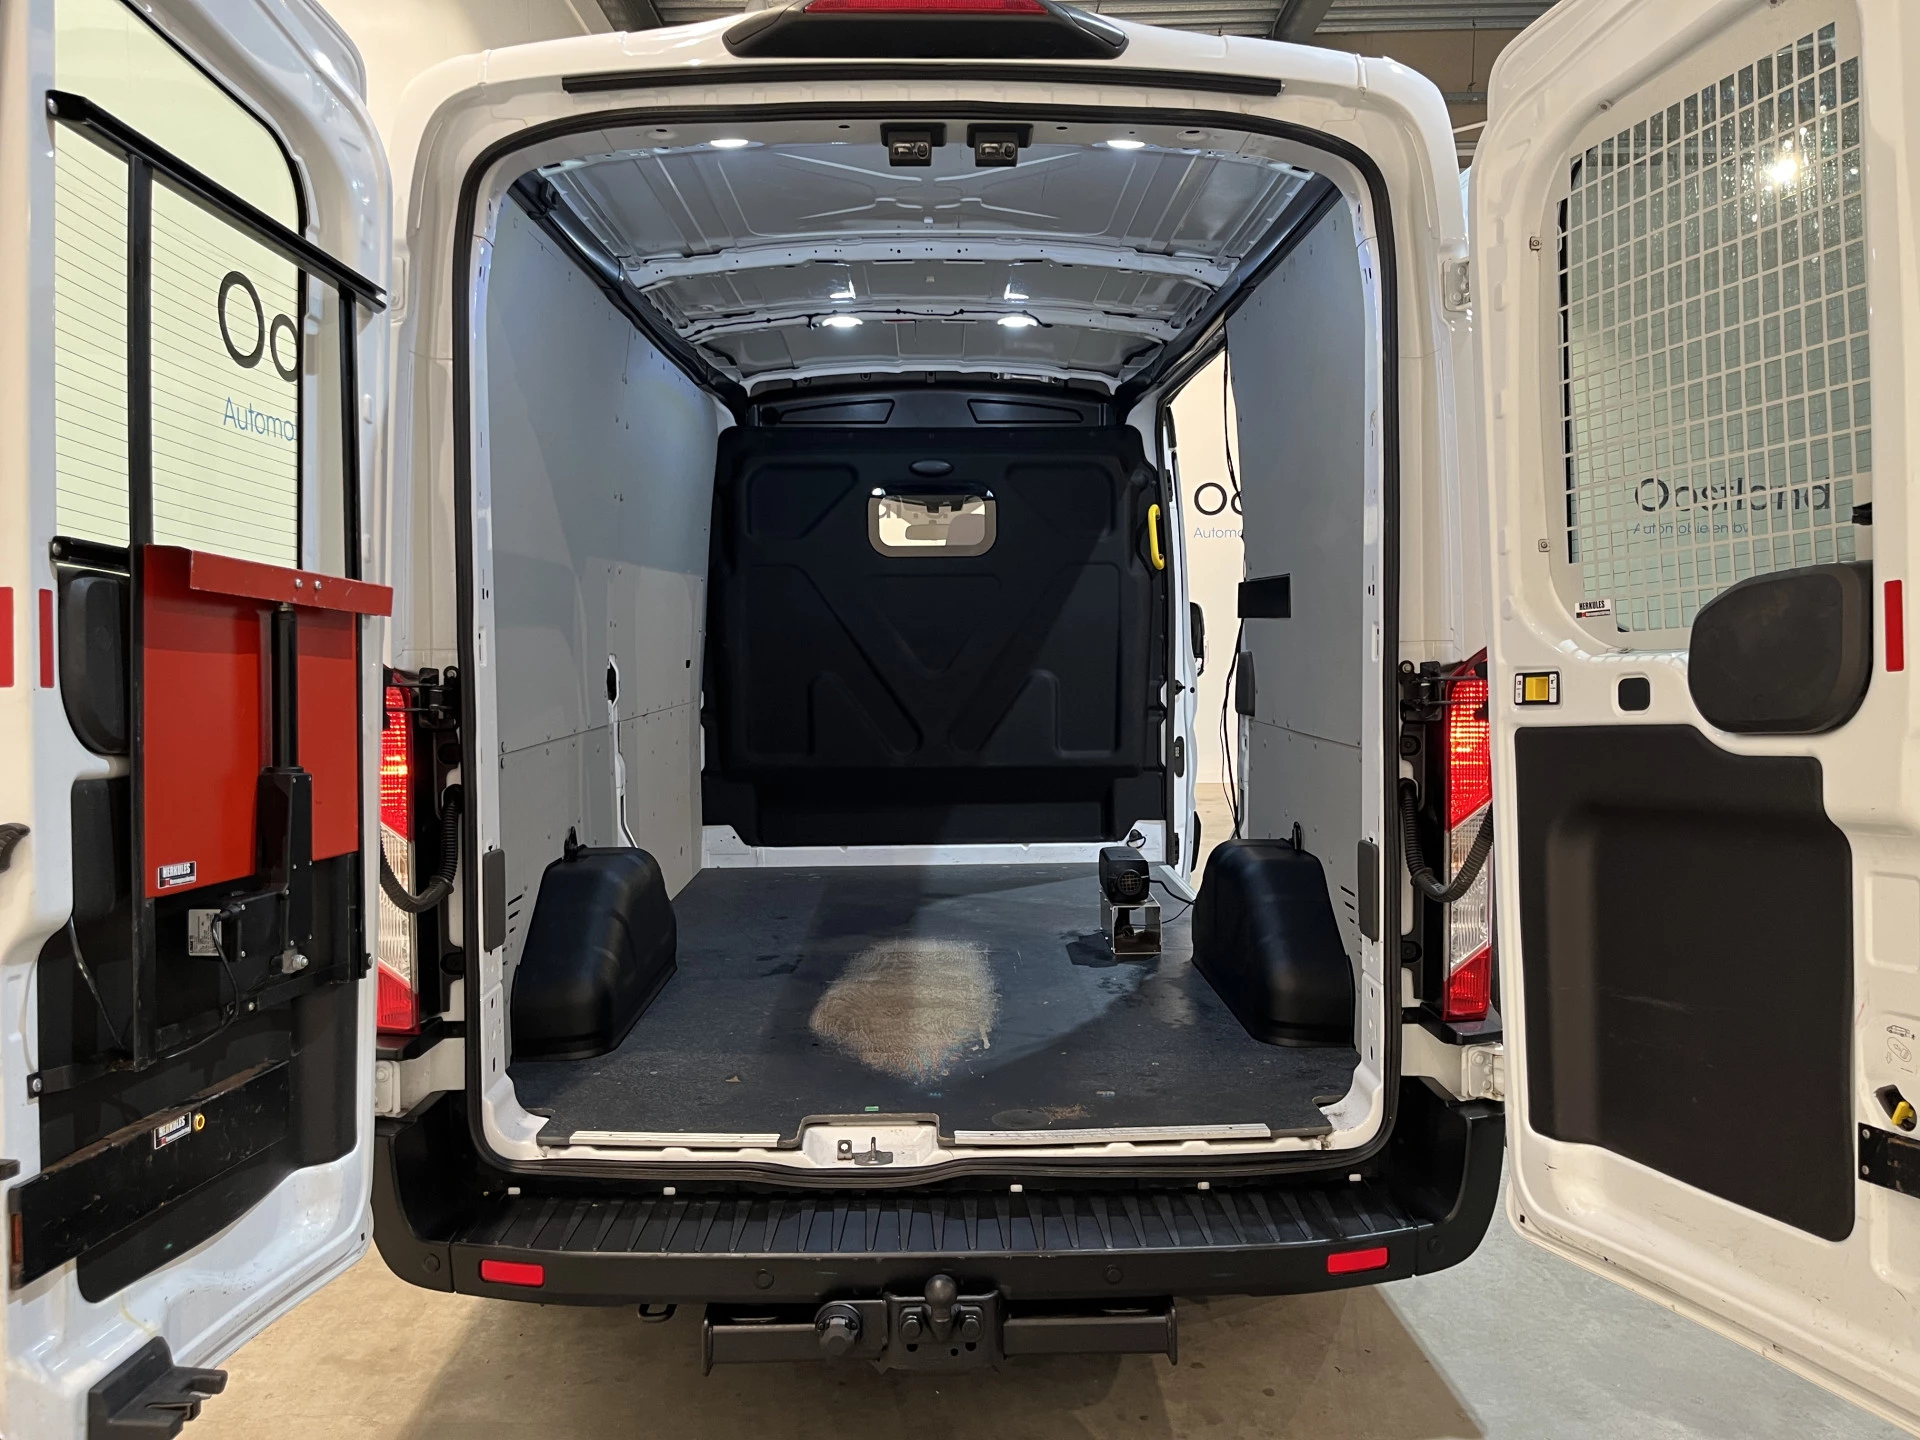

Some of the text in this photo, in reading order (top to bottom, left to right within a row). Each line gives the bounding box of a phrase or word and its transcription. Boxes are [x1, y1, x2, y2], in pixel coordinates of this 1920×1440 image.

[224, 397, 297, 441] Automo
[1634, 477, 1831, 512] Oostland
[1633, 522, 1728, 535] Automoieen
[1579, 600, 1605, 610] HERKULES
